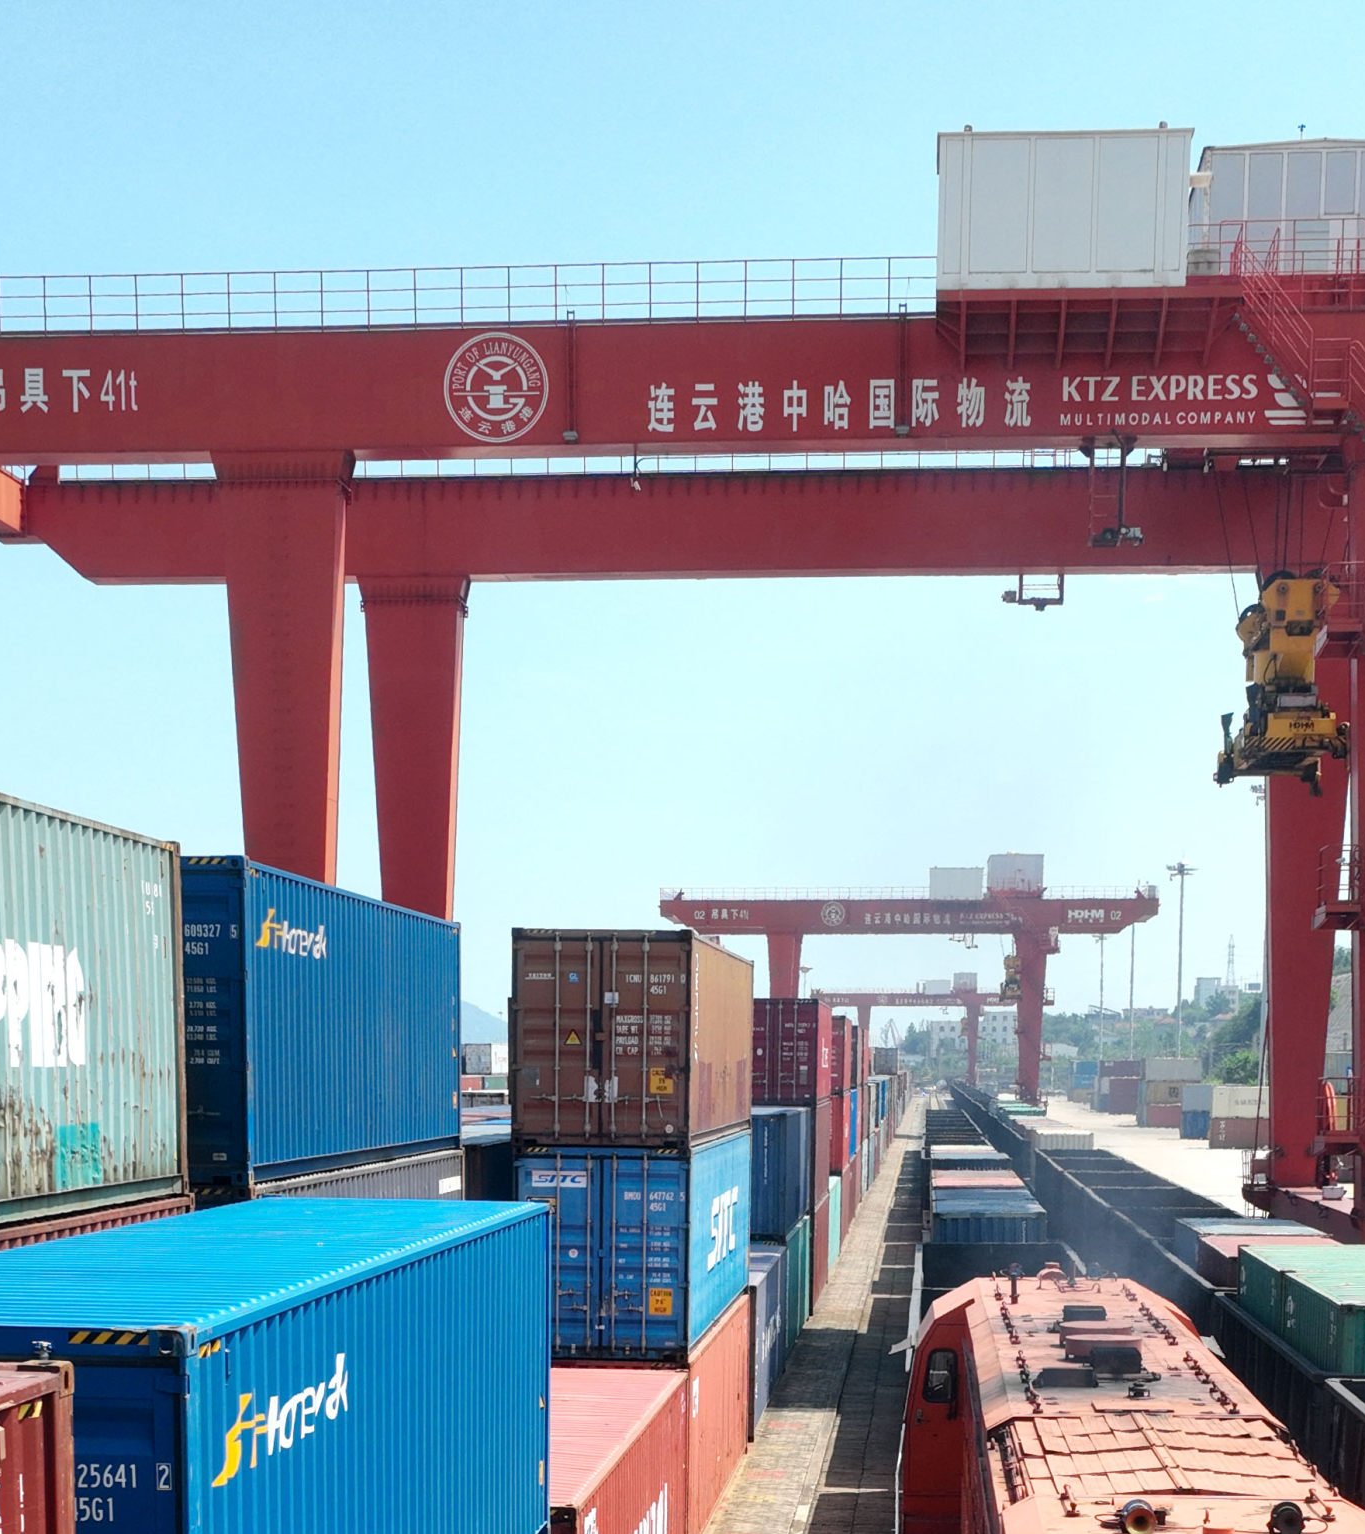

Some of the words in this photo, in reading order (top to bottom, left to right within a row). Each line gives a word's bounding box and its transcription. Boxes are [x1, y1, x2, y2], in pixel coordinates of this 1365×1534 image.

[465, 346, 480, 364] OF
[483, 341, 541, 388] LIANYUNGANG
[1062, 376, 1120, 402] KTZ
[1131, 374, 1258, 401] EXPRESS
[647, 376, 1032, 433] 连云港中哈国际物流
[1060, 412, 1171, 426] MULTIMODAL
[1176, 410, 1256, 425] COMPANY
[535, 1174, 586, 1184] SITC
[707, 1186, 739, 1273] SITC
[157, 1464, 171, 1489] 2
